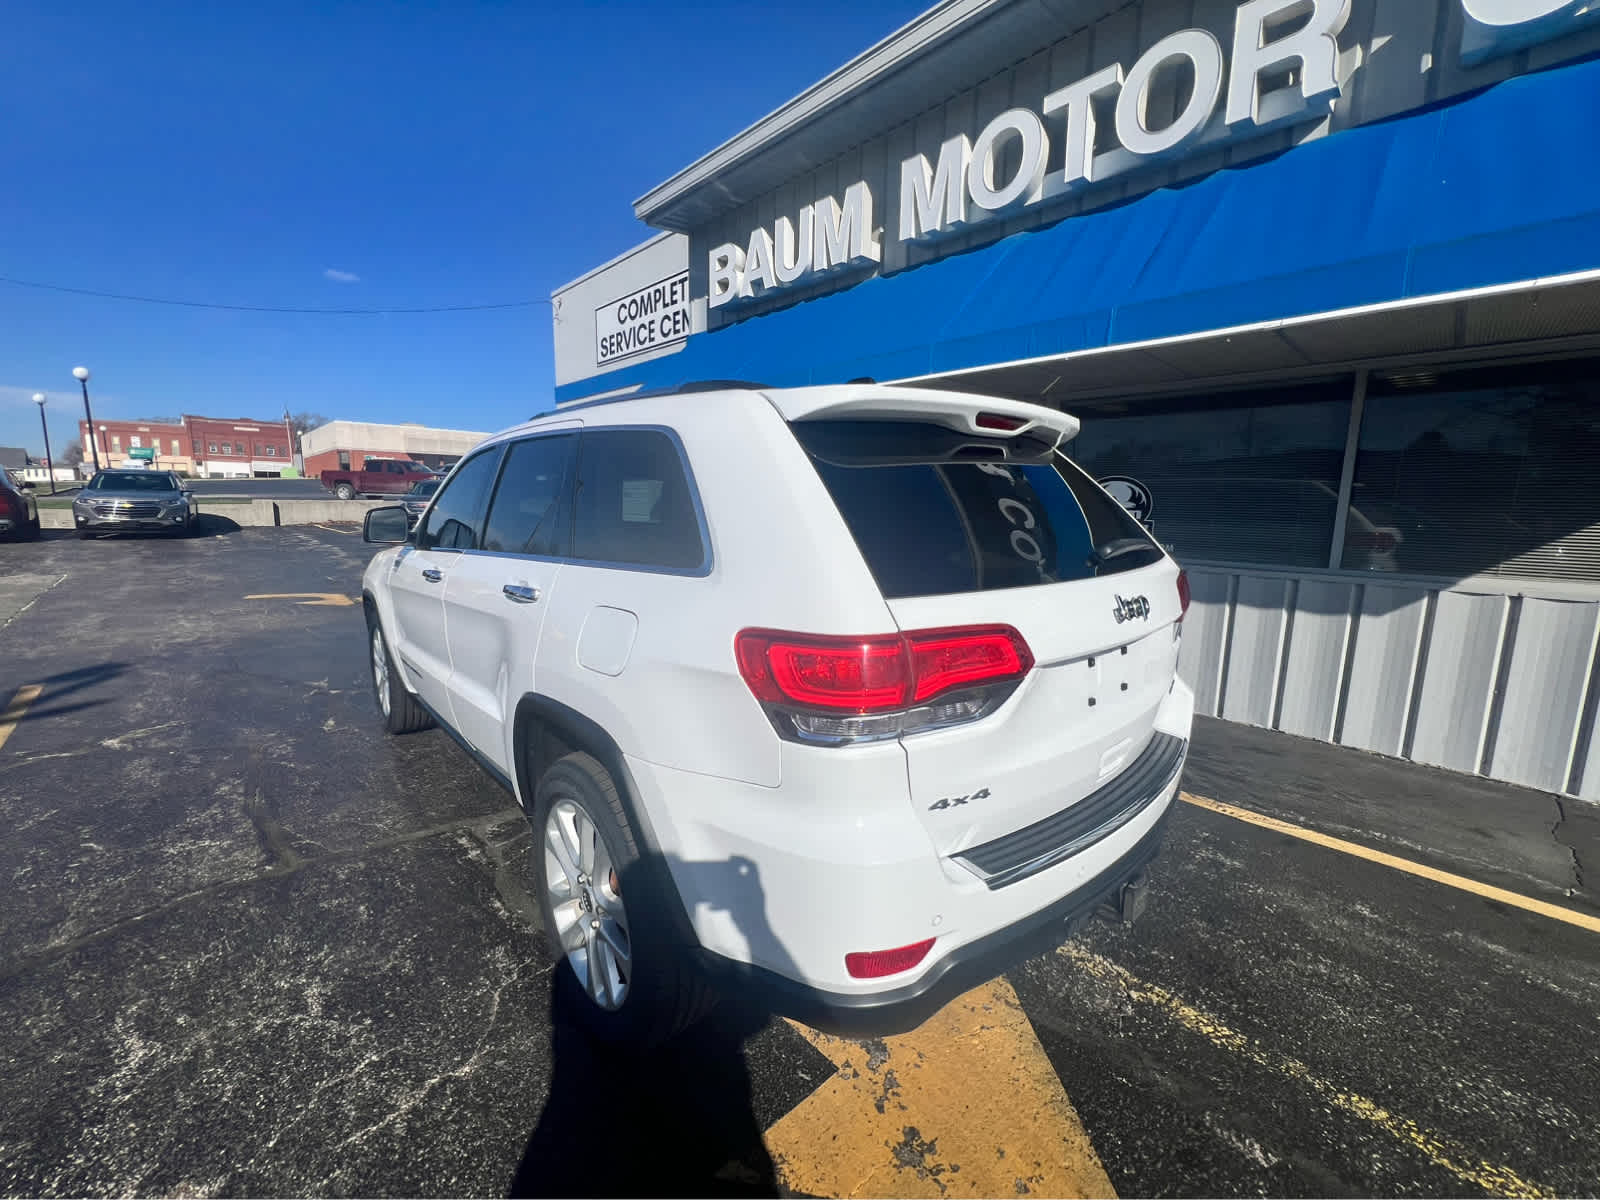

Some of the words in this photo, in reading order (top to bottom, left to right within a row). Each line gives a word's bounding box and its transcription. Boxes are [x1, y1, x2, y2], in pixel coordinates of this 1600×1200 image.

[709, 180, 872, 309] BAUM
[899, 0, 1346, 241] MOTOR
[617, 276, 688, 325] COMPLET
[600, 320, 656, 358] SERVICE
[660, 308, 690, 338] CEN
[1112, 593, 1151, 625] Jeep
[928, 787, 992, 812] 4x4
